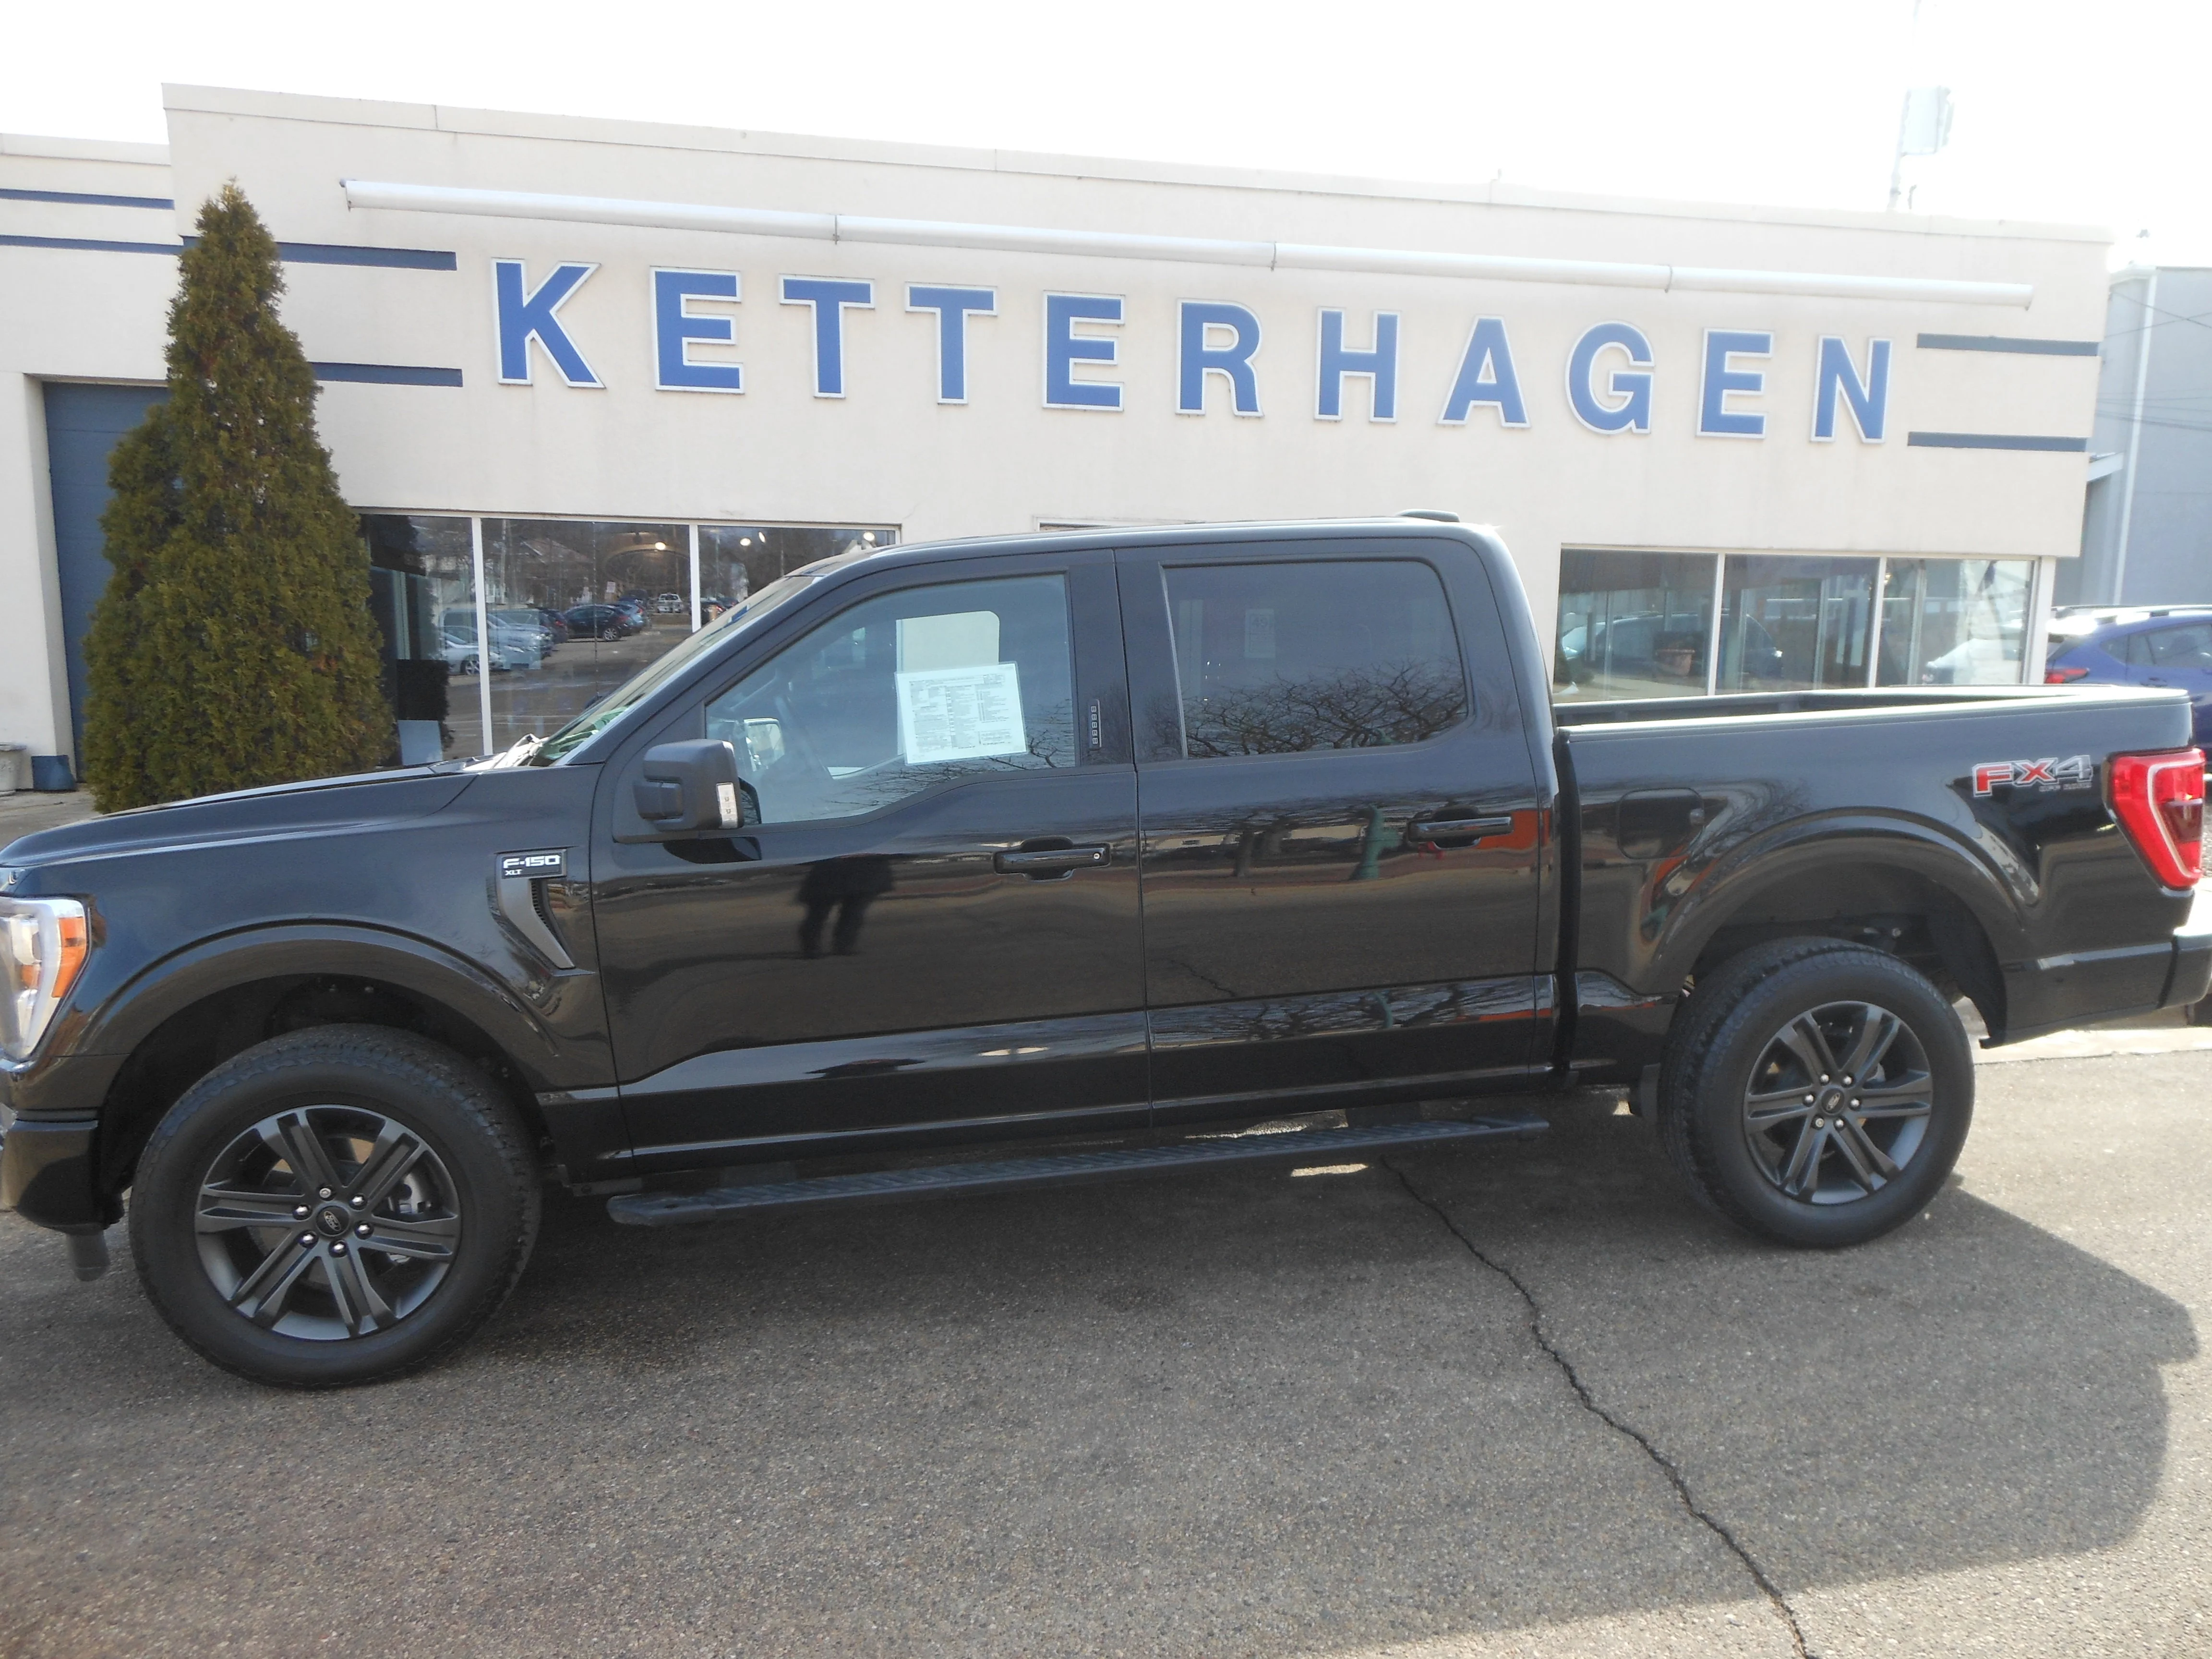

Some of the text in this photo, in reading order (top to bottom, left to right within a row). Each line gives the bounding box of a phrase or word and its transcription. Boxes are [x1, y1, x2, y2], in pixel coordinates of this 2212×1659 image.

[491, 257, 1893, 443] KETTERHAGEN
[1972, 755, 2093, 797] FX4
[503, 854, 561, 868] F-150
